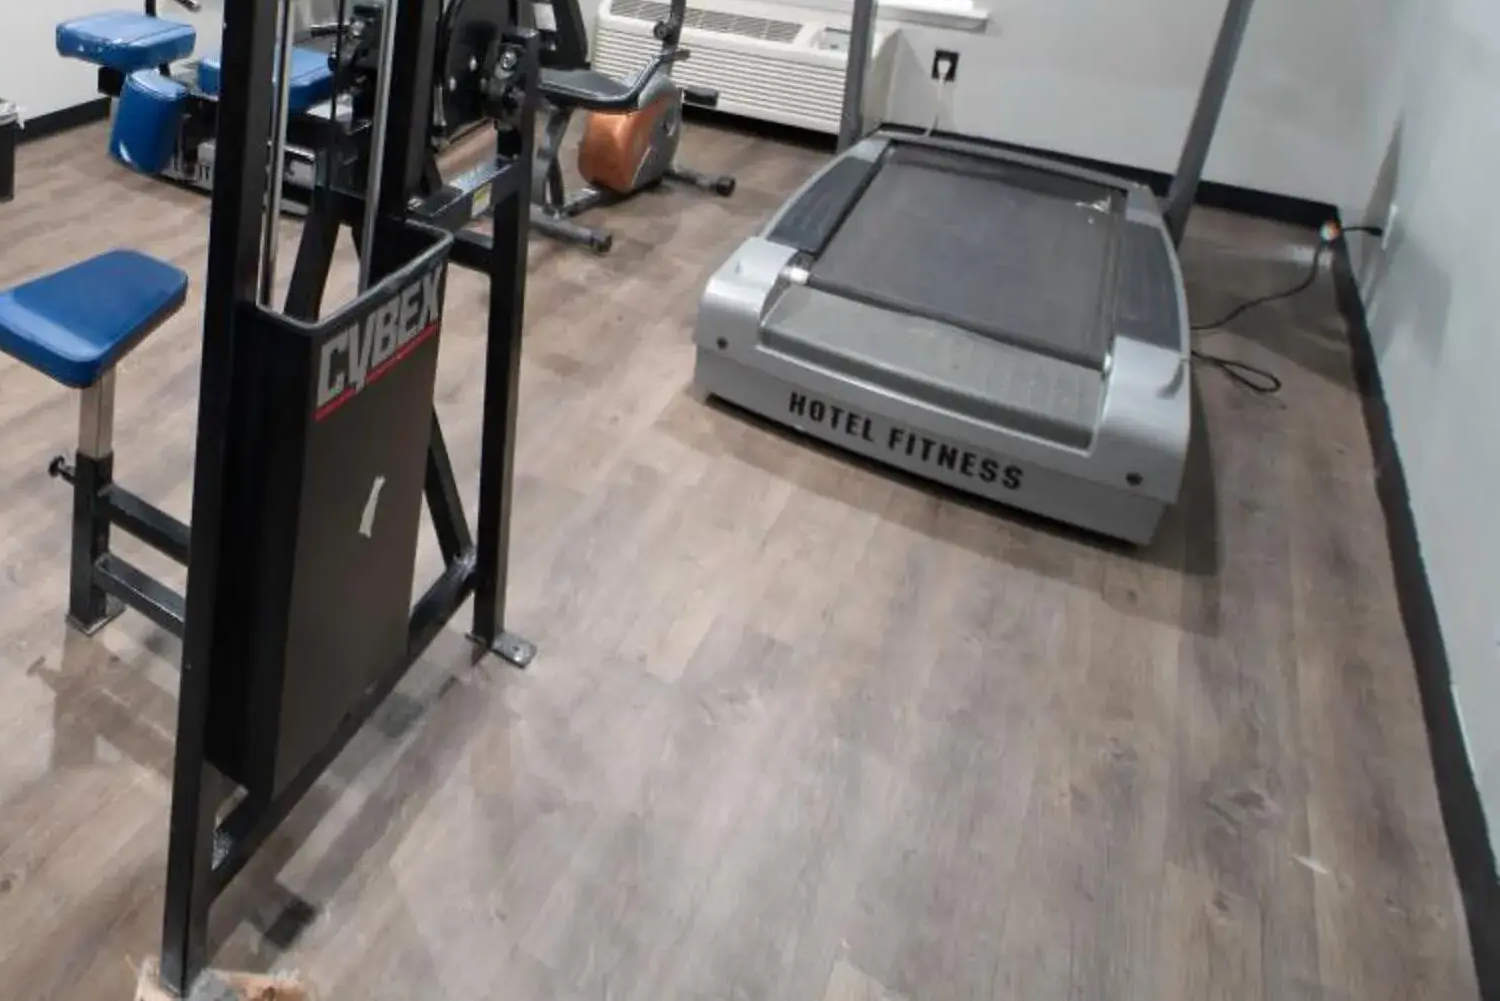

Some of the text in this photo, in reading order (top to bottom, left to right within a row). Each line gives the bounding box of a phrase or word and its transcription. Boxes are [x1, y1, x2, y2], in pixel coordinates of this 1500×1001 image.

[316, 264, 443, 407] CYBEX
[788, 390, 1025, 490] HOTEL FITNESS
